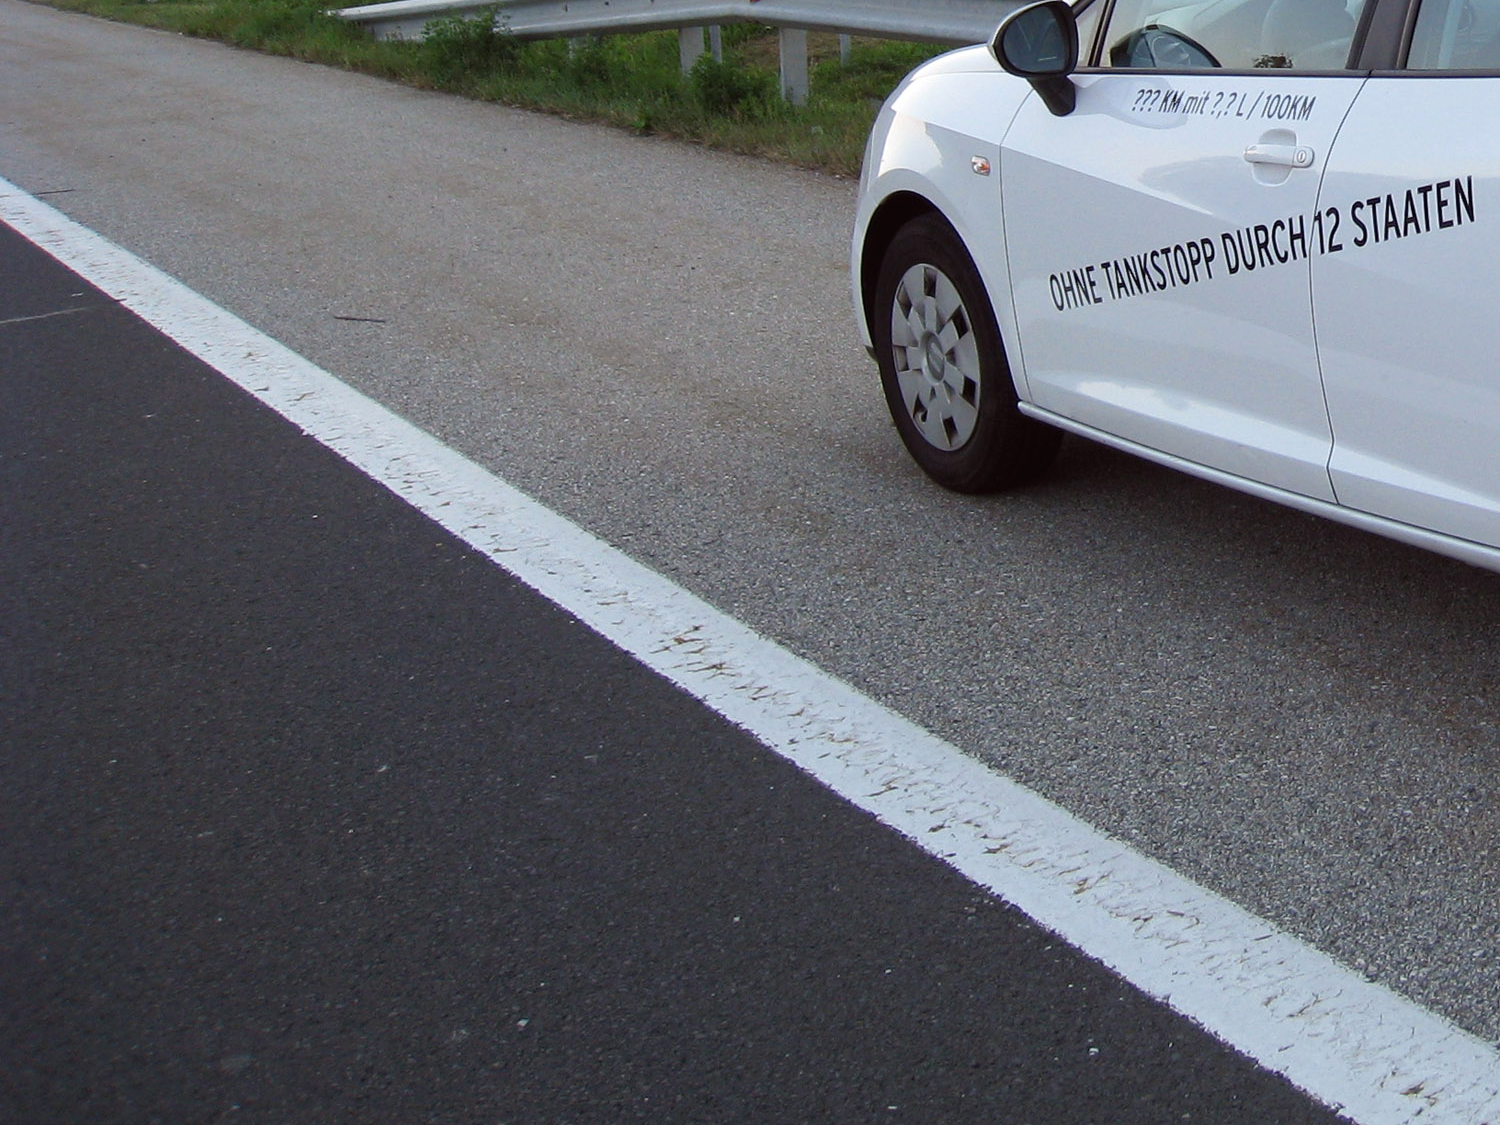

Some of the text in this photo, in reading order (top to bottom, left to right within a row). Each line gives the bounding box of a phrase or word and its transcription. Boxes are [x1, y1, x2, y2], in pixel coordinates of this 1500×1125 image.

[1132, 89, 1160, 112] ???
[1159, 90, 1185, 113] KM
[1182, 91, 1210, 115] mit
[1049, 176, 1476, 312] OHNE TANKSTOPP DURCH 12 STAATEN
